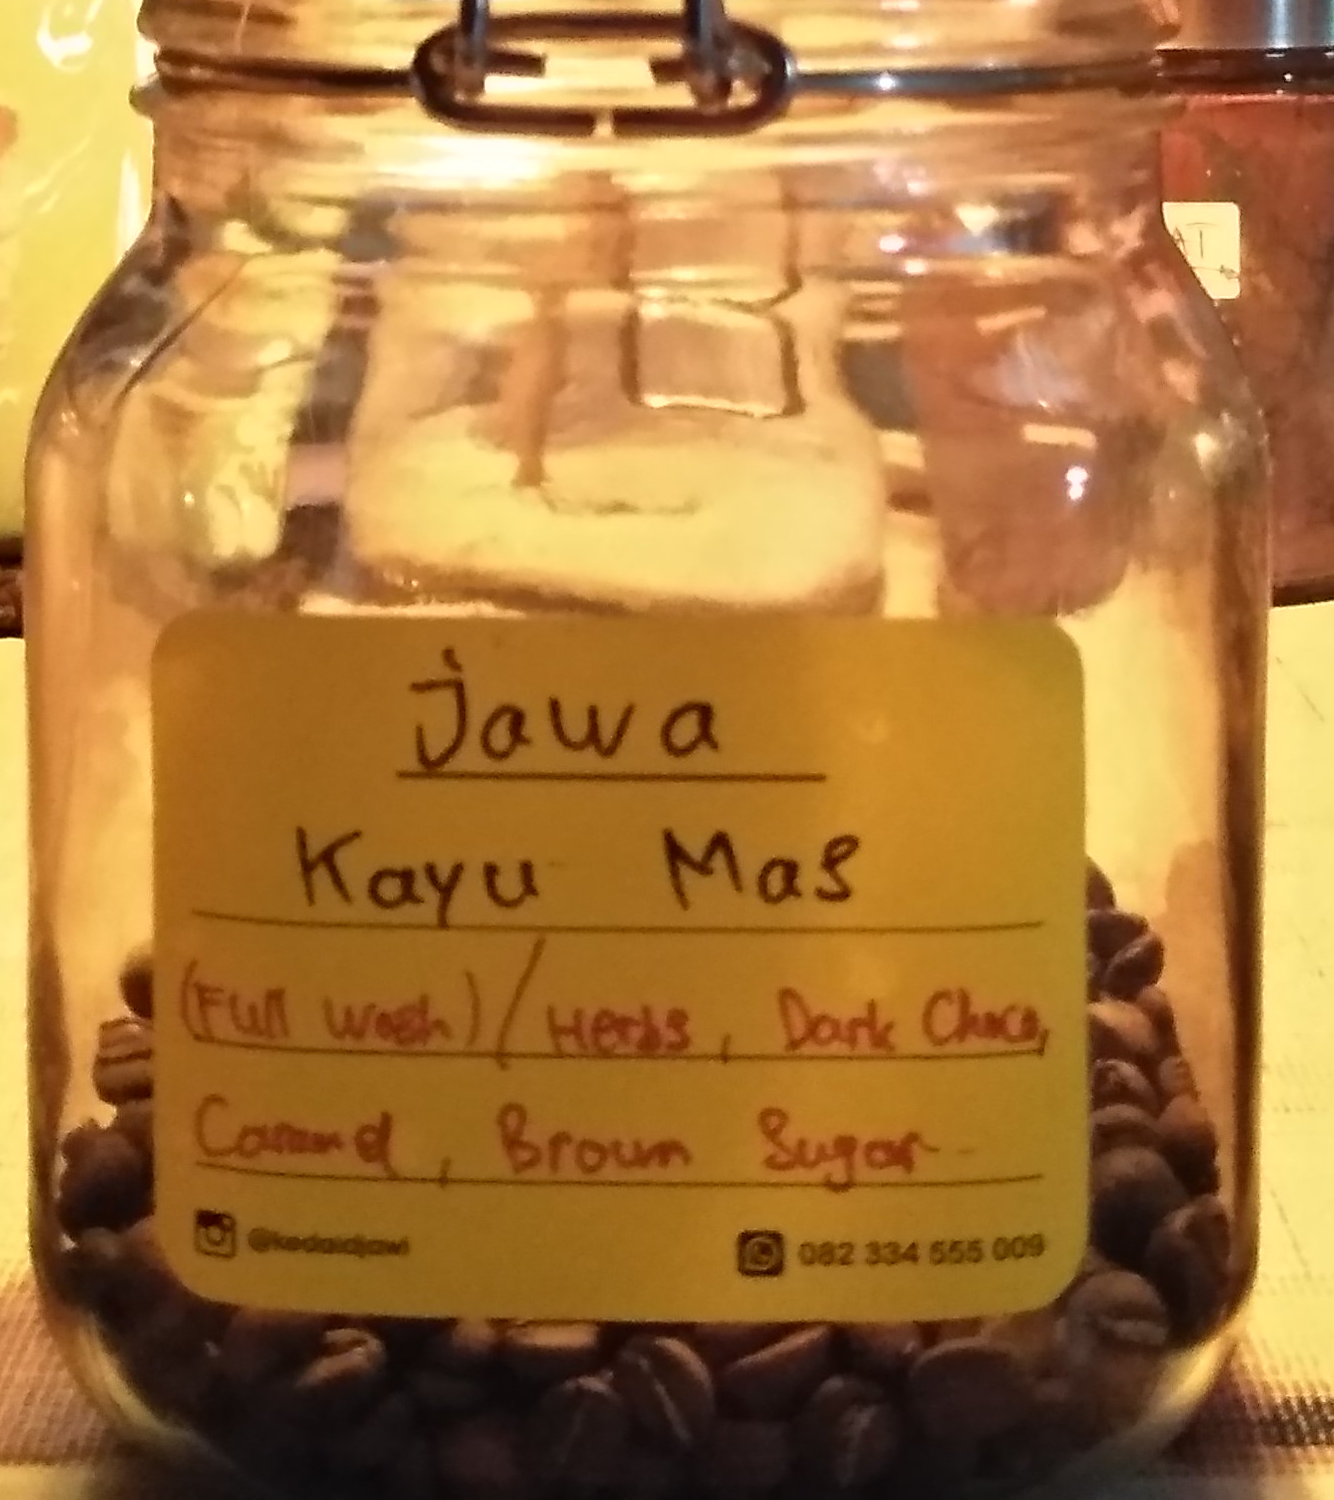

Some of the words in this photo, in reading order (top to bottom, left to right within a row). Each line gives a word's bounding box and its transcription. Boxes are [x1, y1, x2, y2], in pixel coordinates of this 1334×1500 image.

[293, 824, 543, 930] Kayu
[661, 828, 864, 911] Mas
[778, 986, 896, 1053] Dark
[496, 1102, 694, 1176] Brown
[757, 1106, 933, 1193] Sugar
[798, 1240, 855, 1267] 082
[864, 1240, 919, 1267] 334
[928, 1238, 985, 1266] 555
[991, 1232, 1046, 1262] 009
